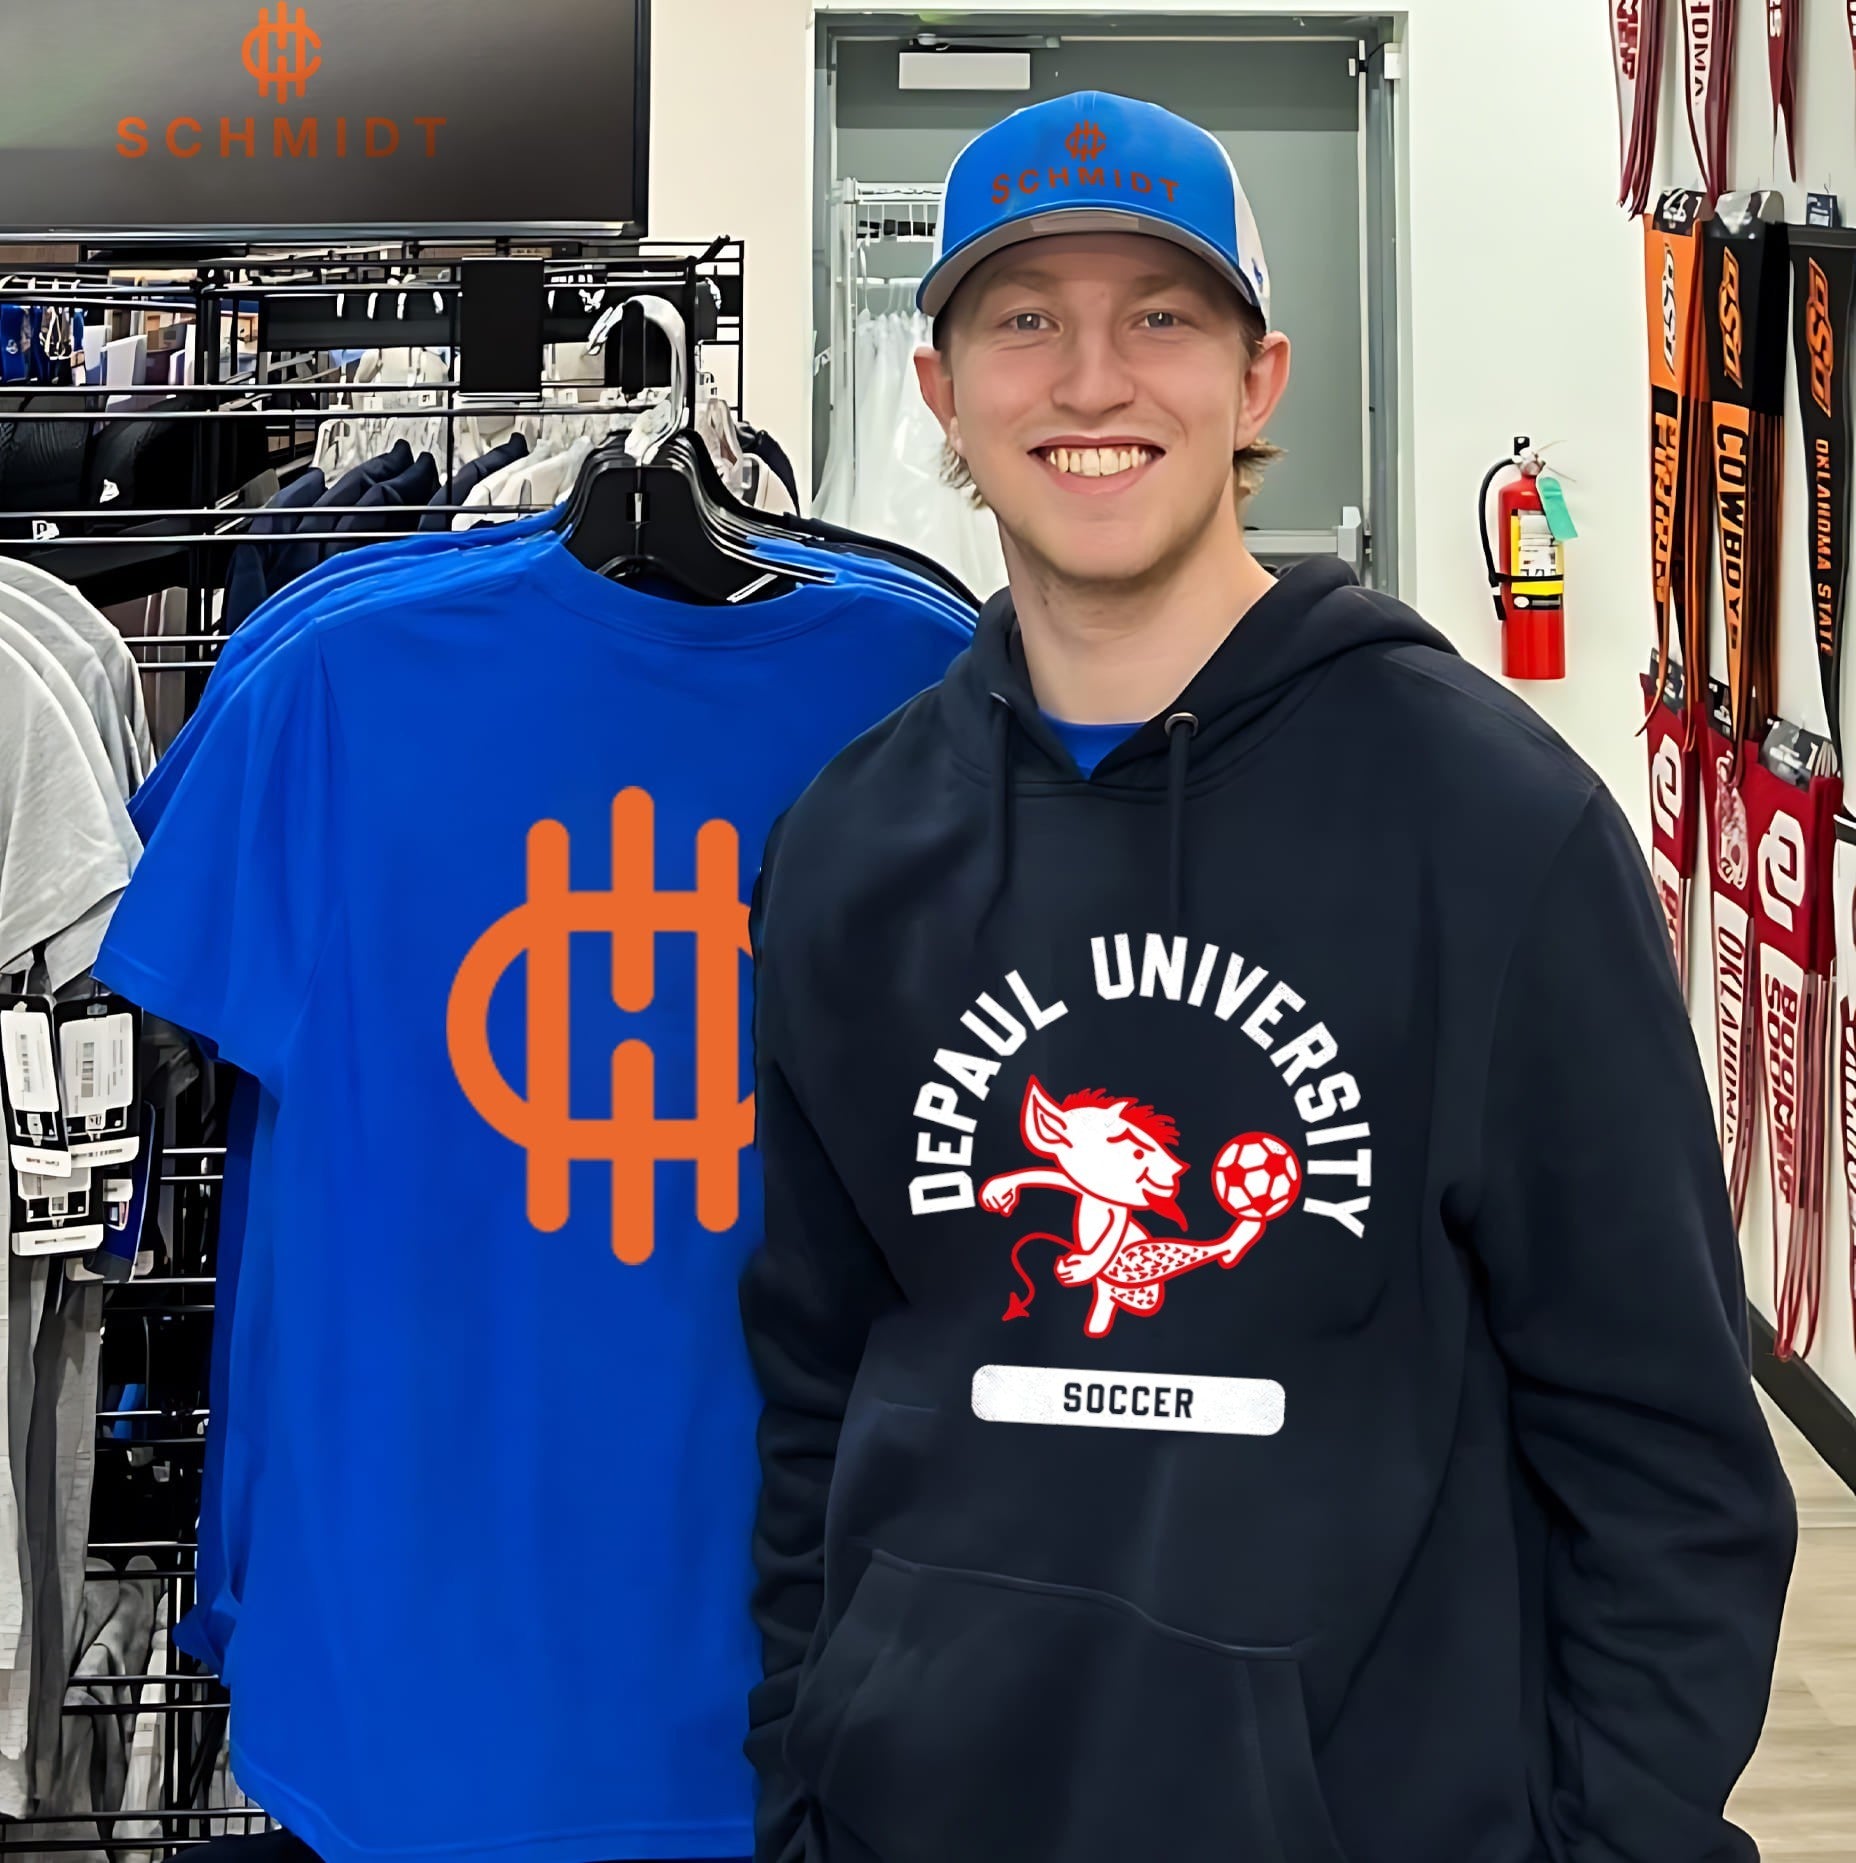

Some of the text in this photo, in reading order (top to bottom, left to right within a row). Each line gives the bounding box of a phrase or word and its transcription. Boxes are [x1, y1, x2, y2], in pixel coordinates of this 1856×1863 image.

[116, 117, 447, 158] SCHMIDT
[991, 167, 1179, 204] SCHMIDT
[1815, 438, 1832, 570] OKLAHOMA
[1718, 926, 1745, 1144] OKLAHOMA
[909, 932, 1372, 1239] DEPAUL UNIVERSITY
[1064, 1382, 1194, 1419] SOCCER
